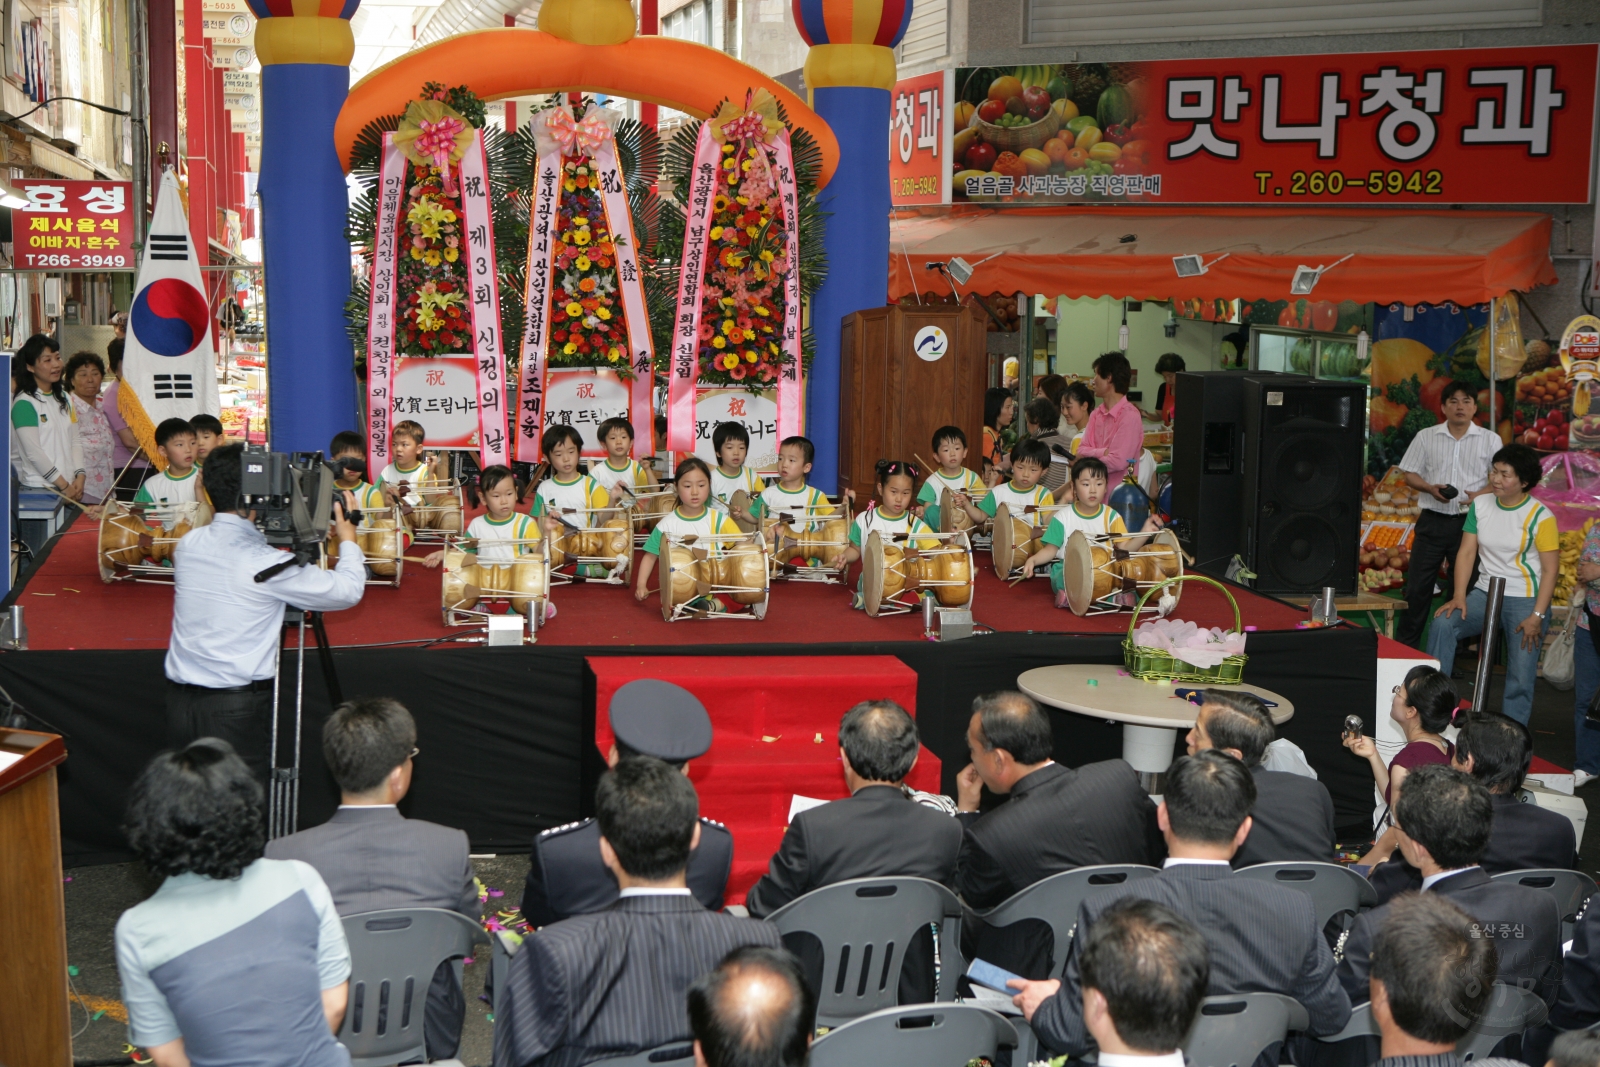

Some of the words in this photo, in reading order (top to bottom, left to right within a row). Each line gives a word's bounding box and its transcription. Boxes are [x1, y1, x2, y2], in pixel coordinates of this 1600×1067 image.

[889, 88, 941, 164] 청과
[1166, 65, 1564, 162] 맛나청과
[22, 185, 126, 214] 효성
[691, 162, 716, 220] 울산광역시
[965, 176, 1014, 196] 얼음골
[1018, 175, 1086, 195] 사과농장
[1092, 174, 1161, 195] 직영판매
[29, 217, 119, 233] 제사음식
[534, 167, 557, 254] 울산광역시
[374, 268, 394, 306] 상인회
[464, 176, 486, 198] 祝
[484, 429, 505, 454] 날
[678, 313, 696, 337] 회장
[1574, 333, 1599, 344] Dole
[371, 335, 391, 379] 권창국
[426, 369, 446, 386] 祝
[576, 382, 596, 399] 祝
[727, 397, 747, 417] 祝
